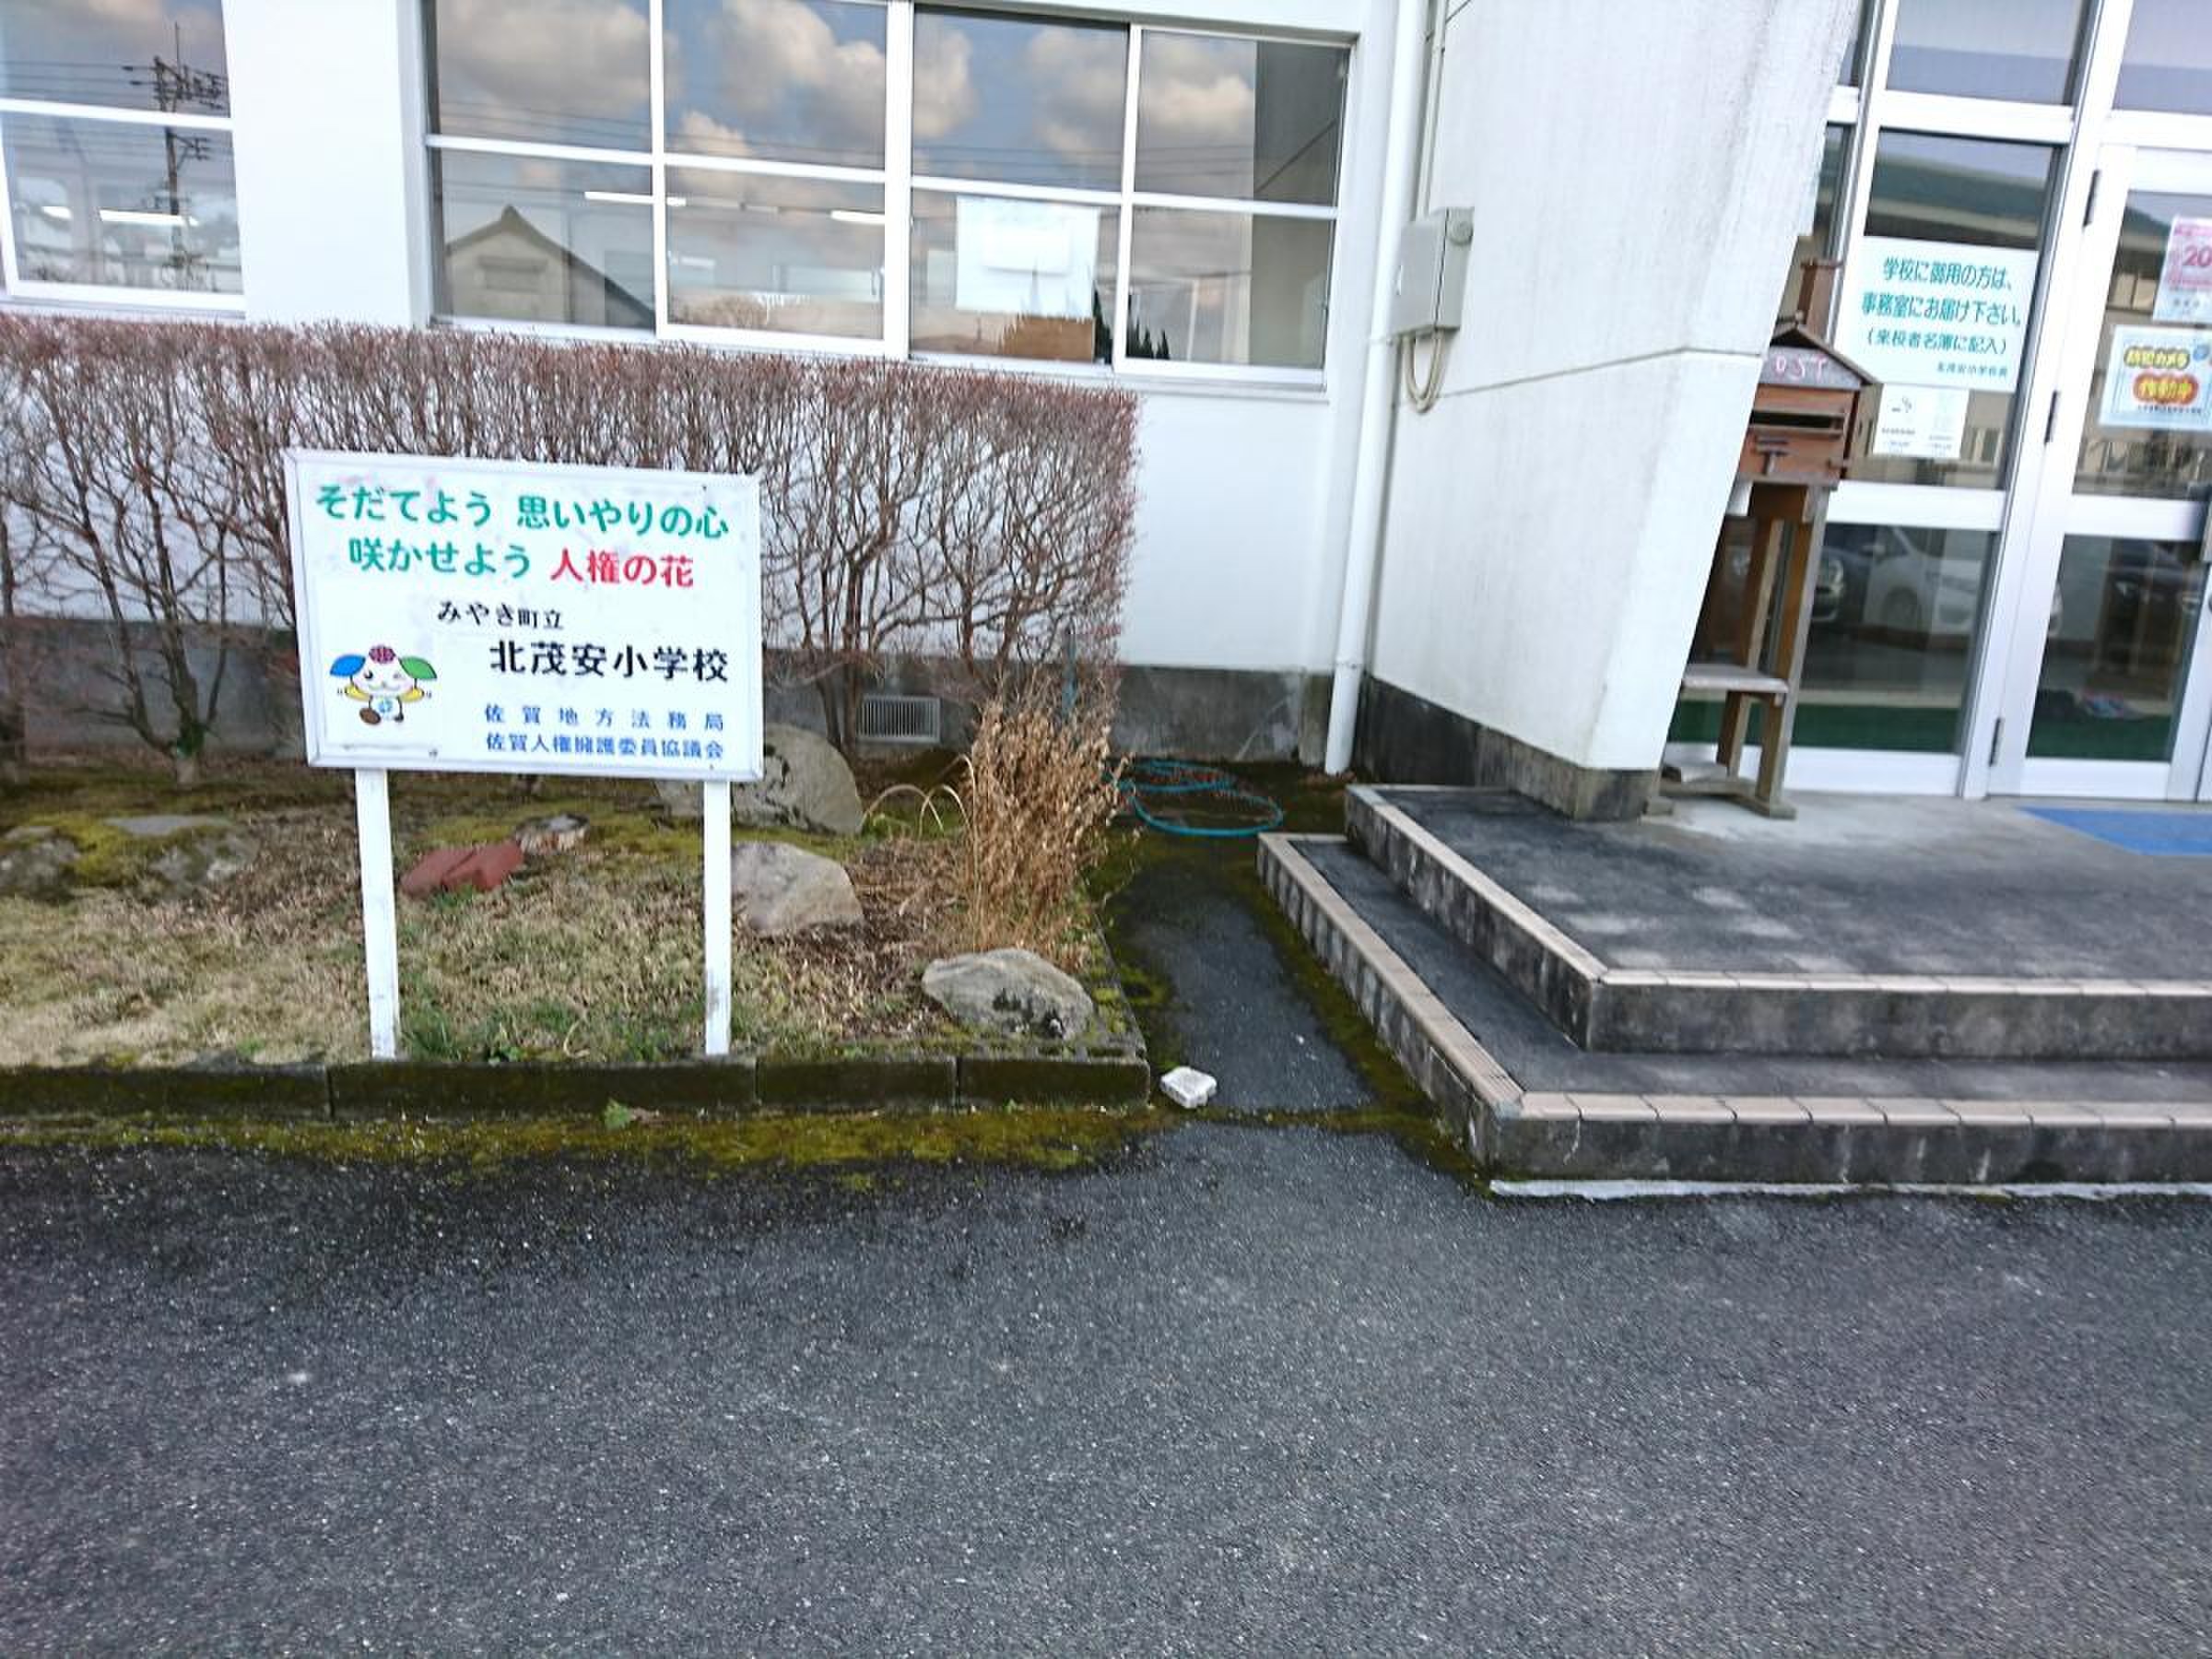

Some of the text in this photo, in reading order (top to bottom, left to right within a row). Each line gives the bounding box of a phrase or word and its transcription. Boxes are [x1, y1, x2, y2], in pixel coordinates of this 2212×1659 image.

[1775, 354, 1828, 383] OST
[316, 484, 729, 539] そだてよう 思いやりの心
[348, 537, 694, 588] 咲かせよう 人権の花
[438, 601, 564, 629] みやき町立
[489, 641, 728, 682] 北茂安小学校
[485, 703, 724, 731] 佐賀地方法務局
